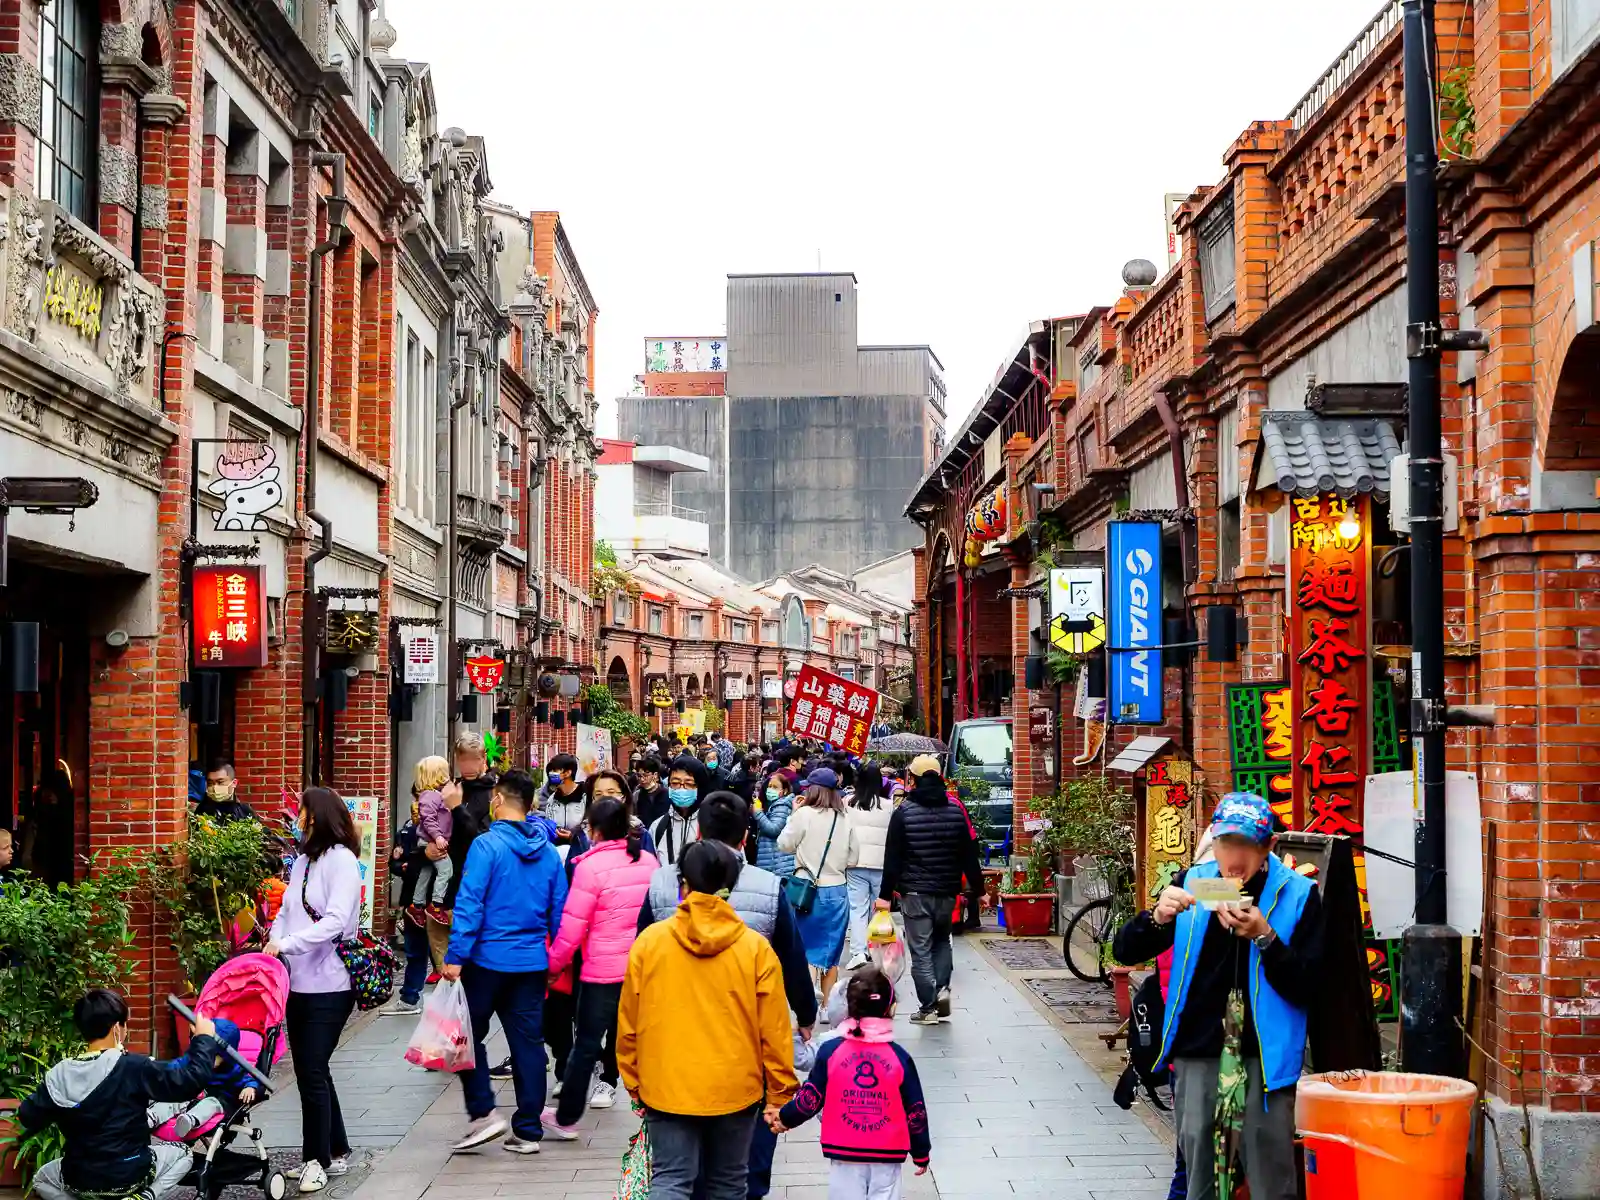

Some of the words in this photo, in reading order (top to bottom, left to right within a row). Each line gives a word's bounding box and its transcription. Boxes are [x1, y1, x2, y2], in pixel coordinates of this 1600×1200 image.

[215, 573, 224, 587] JIN
[217, 605, 225, 619] XIA
[226, 574, 248, 642] 金三峽
[208, 630, 224, 661] 牛角
[1129, 578, 1149, 697] GIANT
[802, 675, 870, 718] 山藥餅
[843, 1089, 889, 1101] ORIGINAL
